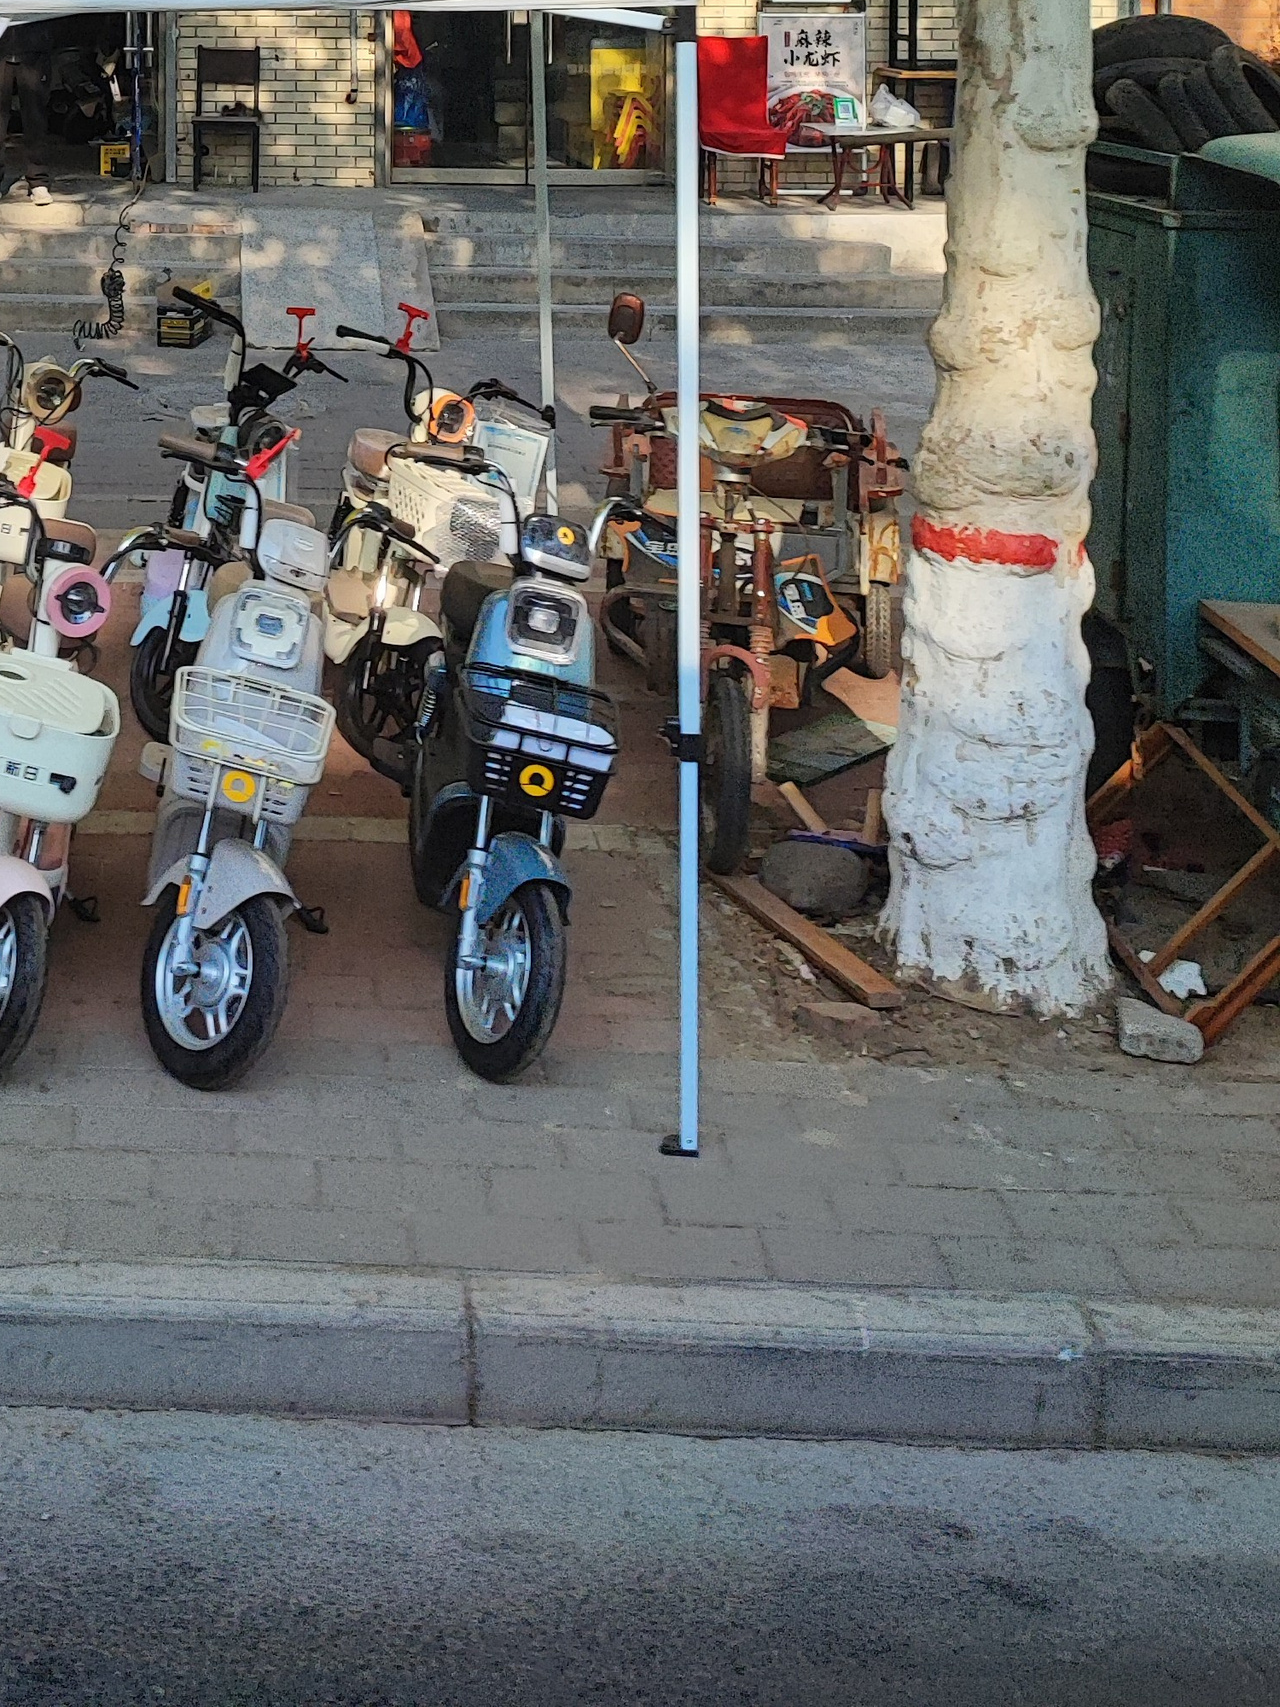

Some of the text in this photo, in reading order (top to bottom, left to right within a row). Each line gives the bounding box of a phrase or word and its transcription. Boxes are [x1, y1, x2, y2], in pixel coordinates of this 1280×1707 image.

[795, 29, 833, 48] 麻辣
[784, 49, 841, 68] 小龙虾
